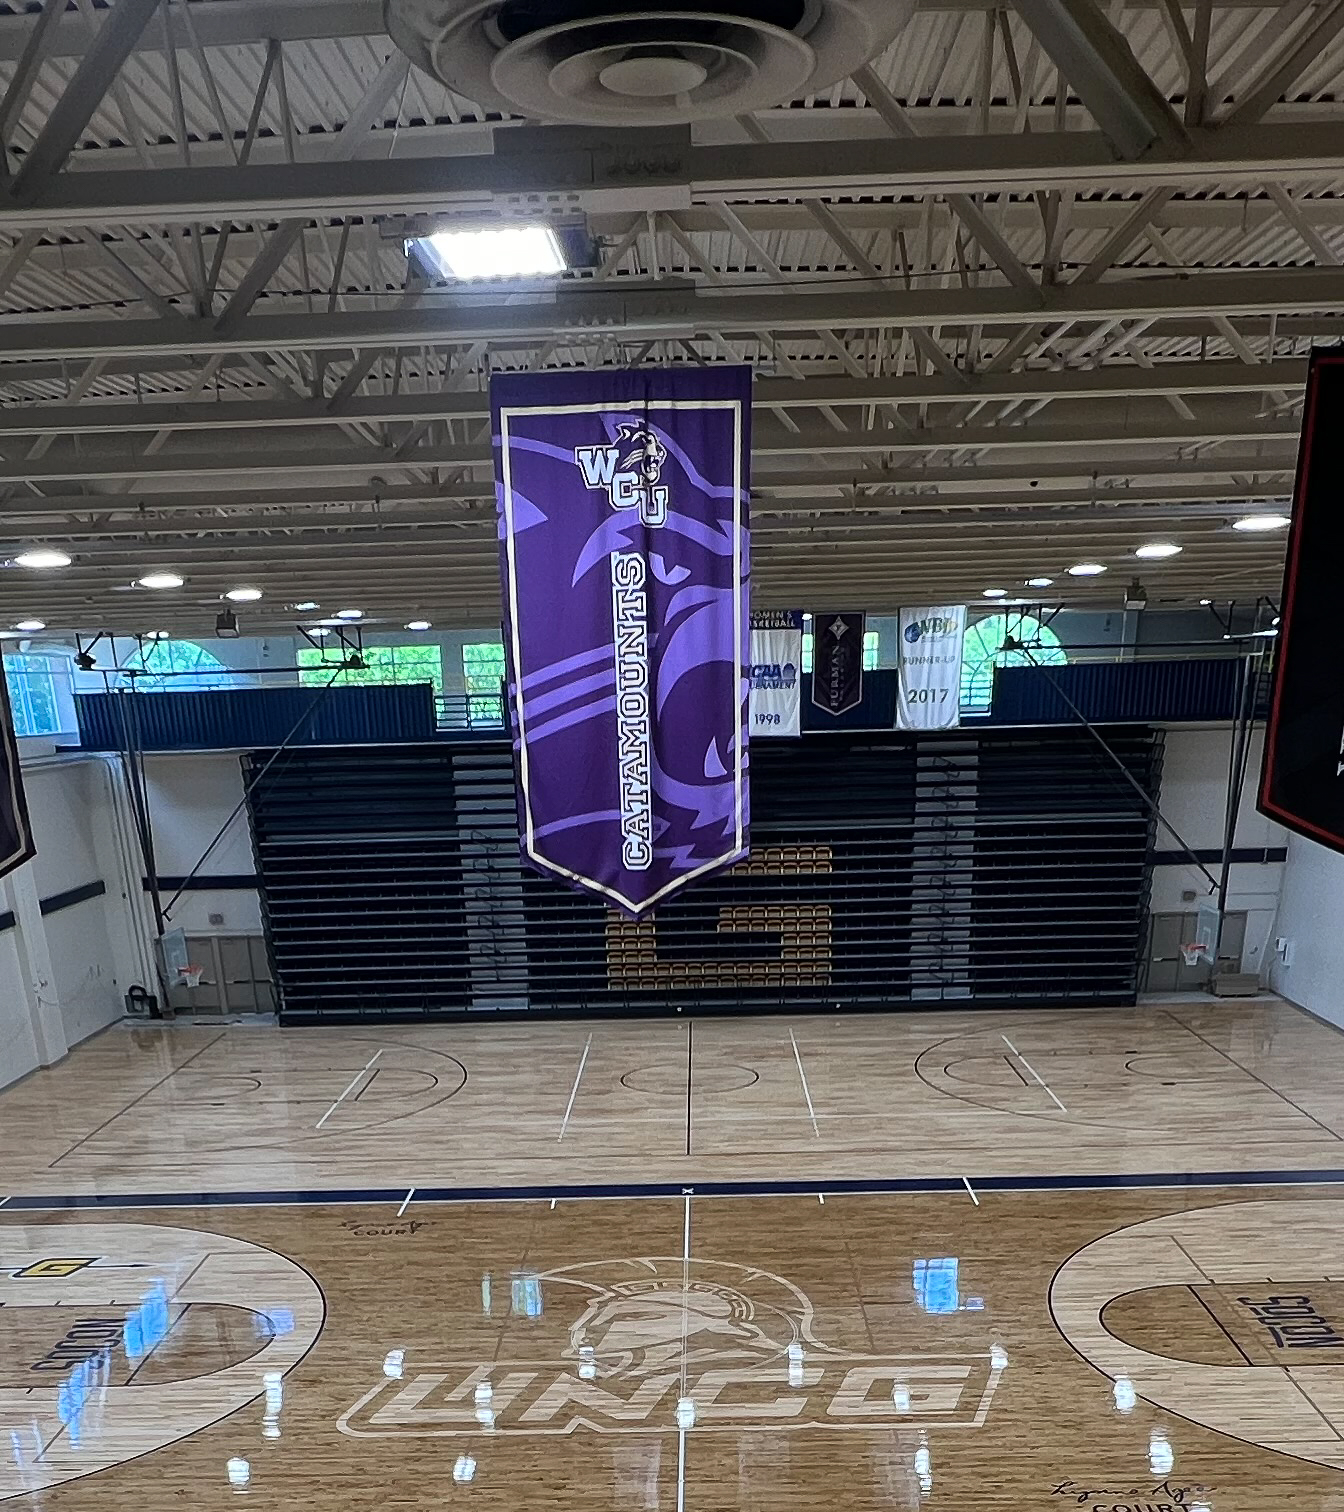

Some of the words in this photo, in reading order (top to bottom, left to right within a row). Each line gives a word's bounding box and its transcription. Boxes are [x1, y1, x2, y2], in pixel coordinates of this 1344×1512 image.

[575, 445, 668, 528] WCU
[750, 610, 793, 619] OMEN'S
[750, 663, 781, 678] CAA
[830, 644, 840, 707] FURMAN
[611, 552, 653, 871] CATAMOUNTS
[908, 688, 949, 704] 2017
[16, 1258, 96, 1277] G
[362, 1362, 978, 1427] UNCG
